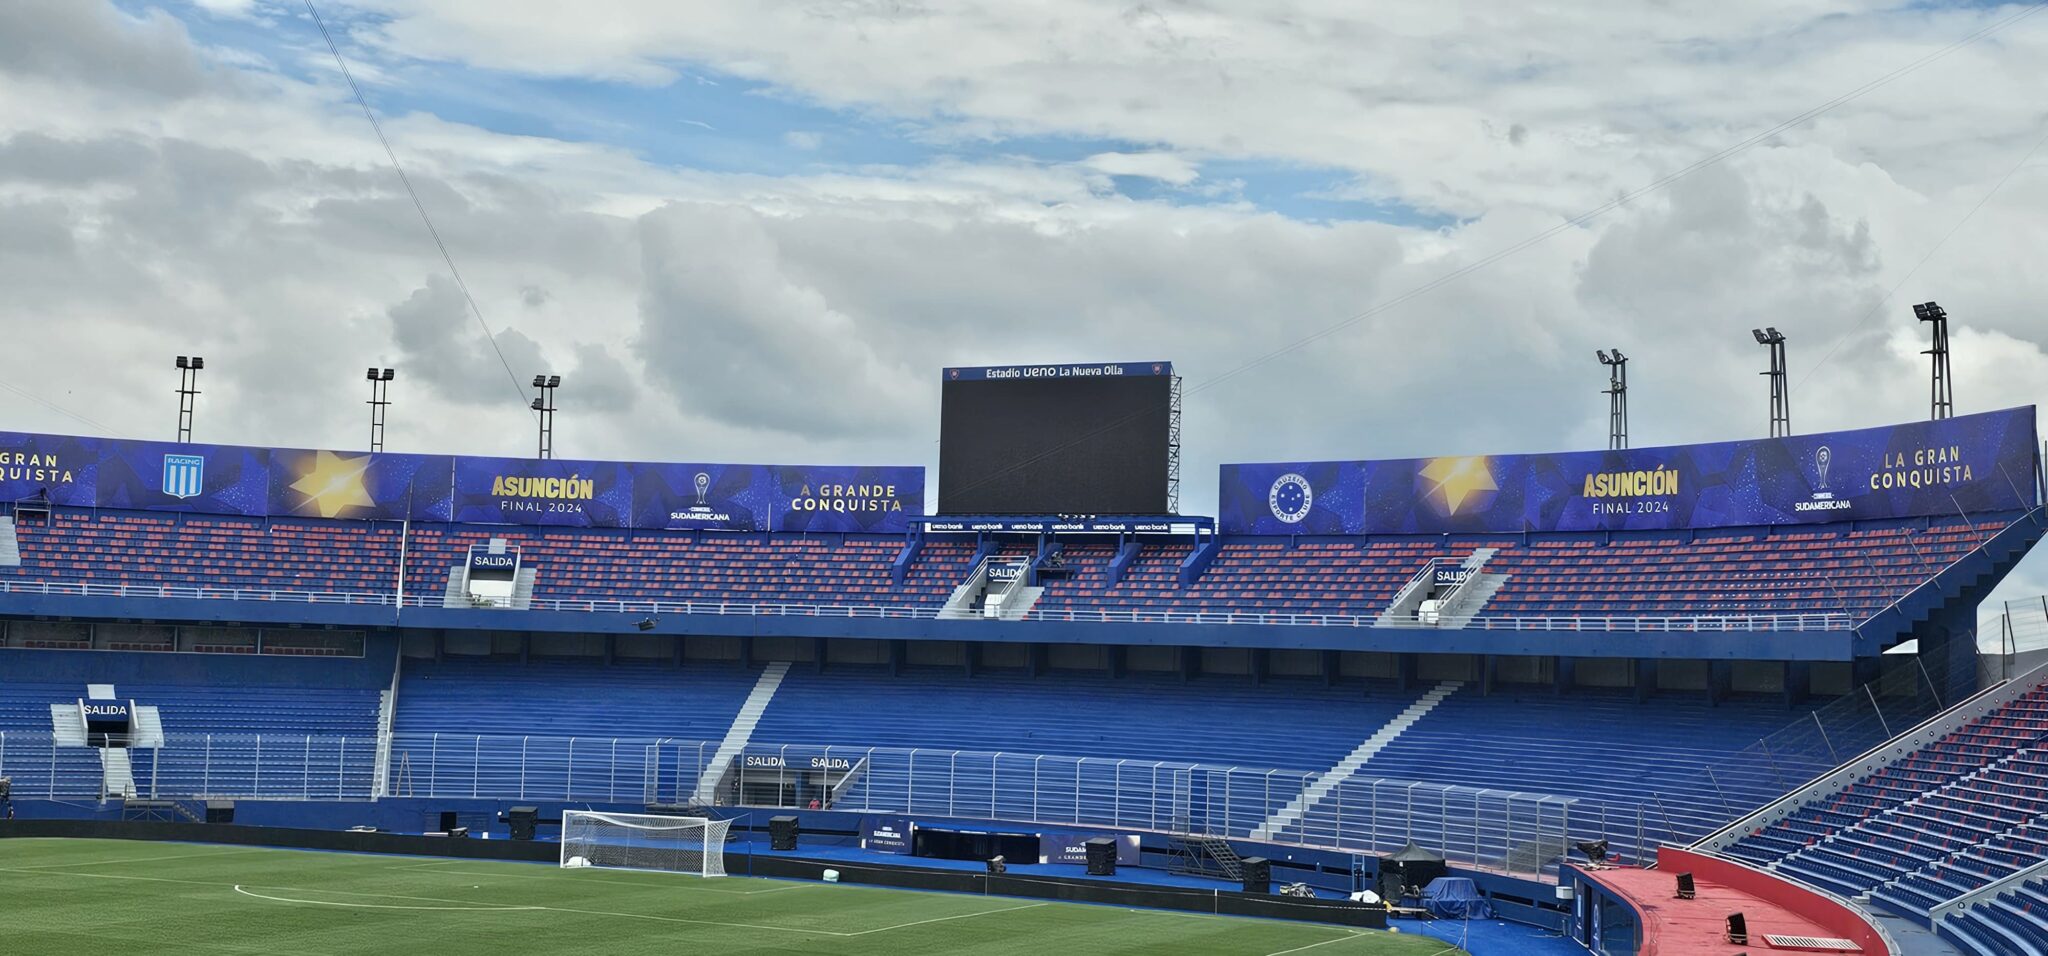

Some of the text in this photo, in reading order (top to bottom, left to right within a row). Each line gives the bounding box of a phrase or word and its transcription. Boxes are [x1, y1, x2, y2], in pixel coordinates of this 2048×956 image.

[986, 365, 1123, 379] Estadio ueno La Nueva Olla
[0, 452, 57, 467] GRAN
[167, 457, 200, 466] RACING
[1885, 446, 1959, 469] LA GRAN
[1273, 475, 1308, 491] CRUZEIRO
[1583, 464, 1678, 498] ASUNCIÓN
[1870, 464, 1972, 490] CONQUISTA
[491, 473, 593, 500] ASUNCIÓN
[800, 484, 895, 497] A GRANDE
[501, 501, 582, 513] FINAL 2024
[791, 498, 902, 513] CONQUISTA
[1593, 501, 1669, 515] FINAL 2024
[1795, 500, 1851, 512] SUDAMERICANA
[670, 512, 730, 522] SUDAMERICANA
[475, 556, 514, 567] SALIDA
[84, 704, 127, 715] SALIDA
[747, 756, 787, 767] SALIDA
[811, 757, 850, 769] SALIDA
